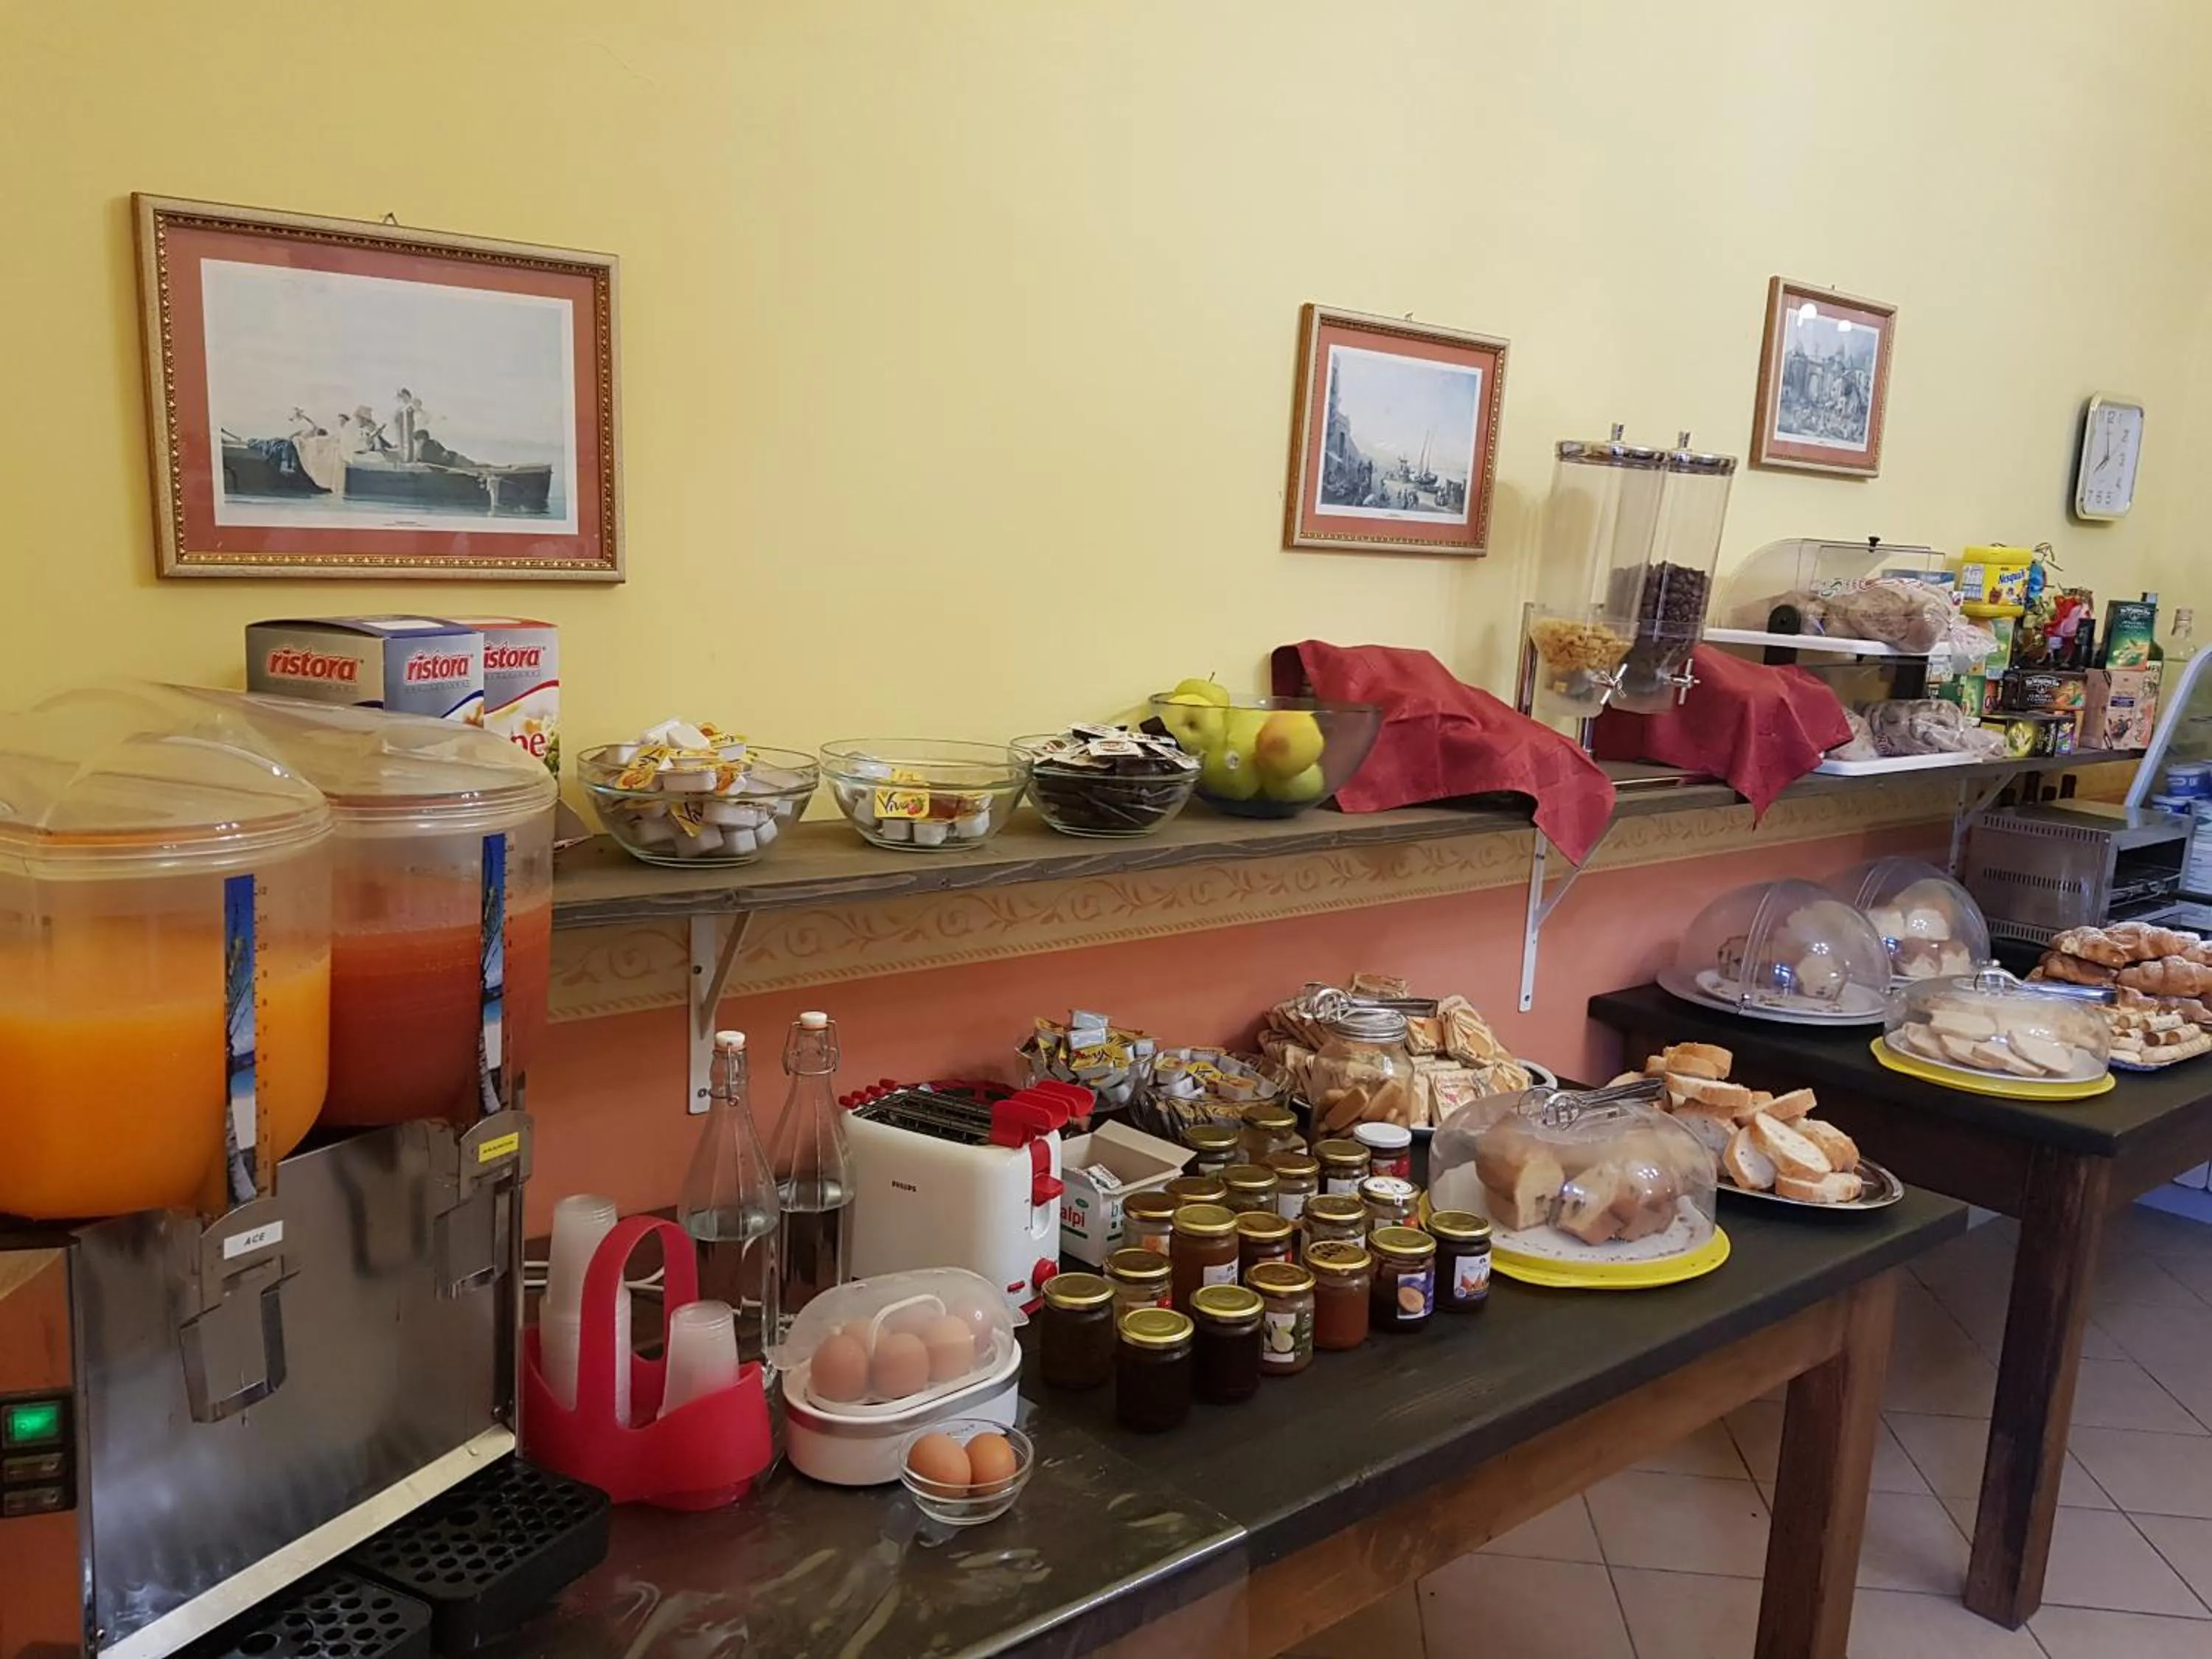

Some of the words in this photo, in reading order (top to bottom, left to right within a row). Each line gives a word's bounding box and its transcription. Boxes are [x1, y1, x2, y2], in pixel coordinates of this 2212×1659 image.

[269, 647, 358, 681] ristora
[406, 655, 470, 681] ristora
[484, 646, 540, 669] istora
[891, 1180, 917, 1192] PHILIPS
[1061, 1206, 1085, 1228] alpi
[243, 1232, 265, 1246] ACE
